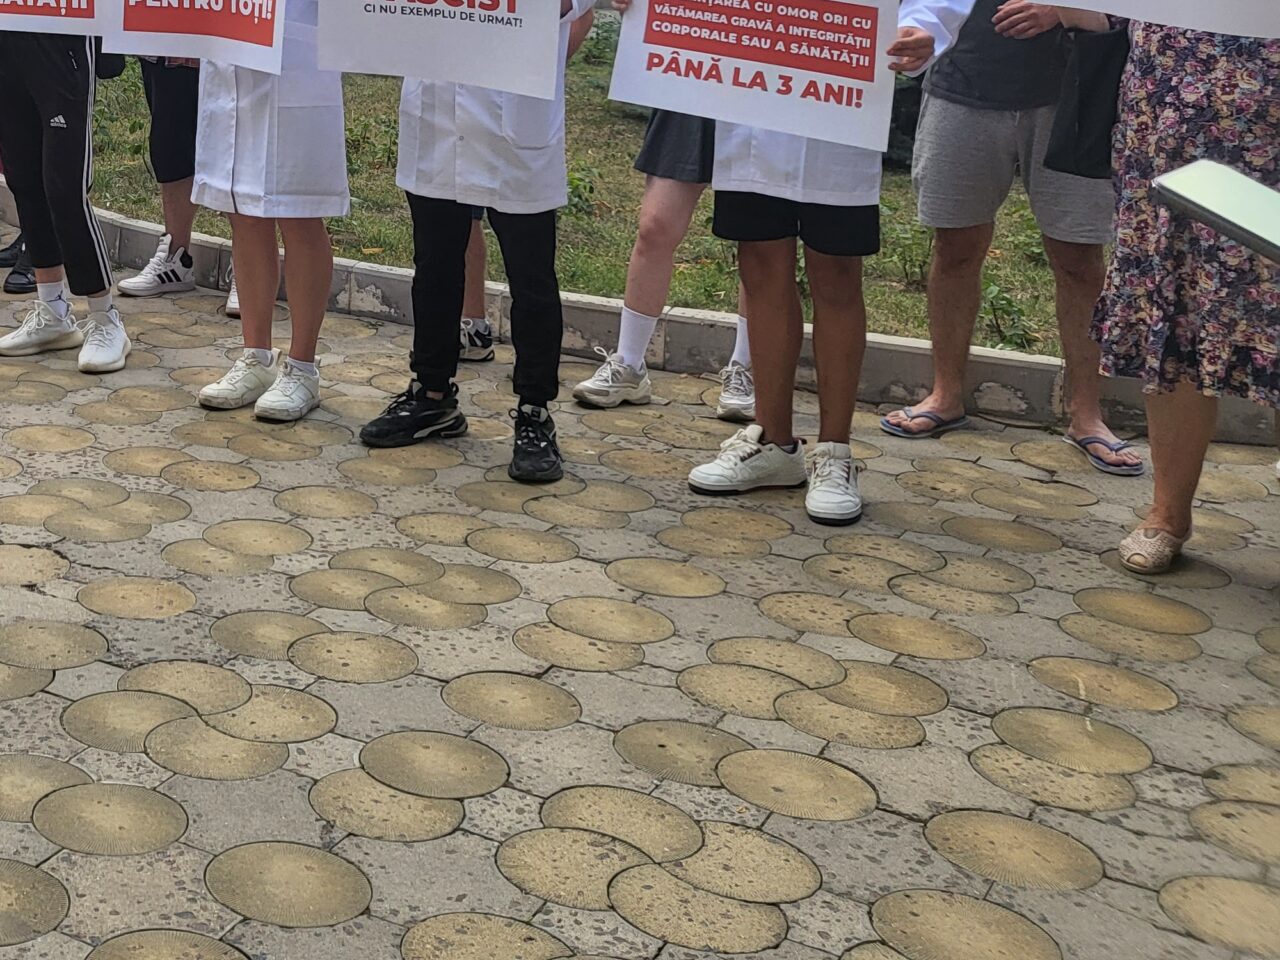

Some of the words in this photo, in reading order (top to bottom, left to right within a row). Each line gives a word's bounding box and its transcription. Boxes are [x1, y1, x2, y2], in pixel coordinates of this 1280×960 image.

[364, 3, 376, 14] CI
[379, 5, 397, 15] NU
[400, 6, 457, 20] EXEMPLU
[459, 11, 475, 23] DE
[478, 14, 523, 28] URMAT!
[654, 3, 728, 25] VĂTĂMAREA
[730, 15, 773, 32] GRAVĂ
[776, 23, 786, 34] A
[788, 26, 871, 50] INTEGRITĂȚII
[754, 1, 773, 13] CU
[777, 5, 819, 21] OMOR
[823, 12, 848, 26] ORI
[852, 17, 872, 30] CU
[652, 21, 737, 44] CORPORALE
[741, 35, 771, 49] SAU
[775, 41, 786, 53] A
[790, 42, 870, 68] SĂNĂTĂȚII
[645, 50, 724, 84] PÂNĂ
[732, 67, 768, 92] LA
[776, 74, 793, 96] 3
[800, 79, 864, 109] ANI!
